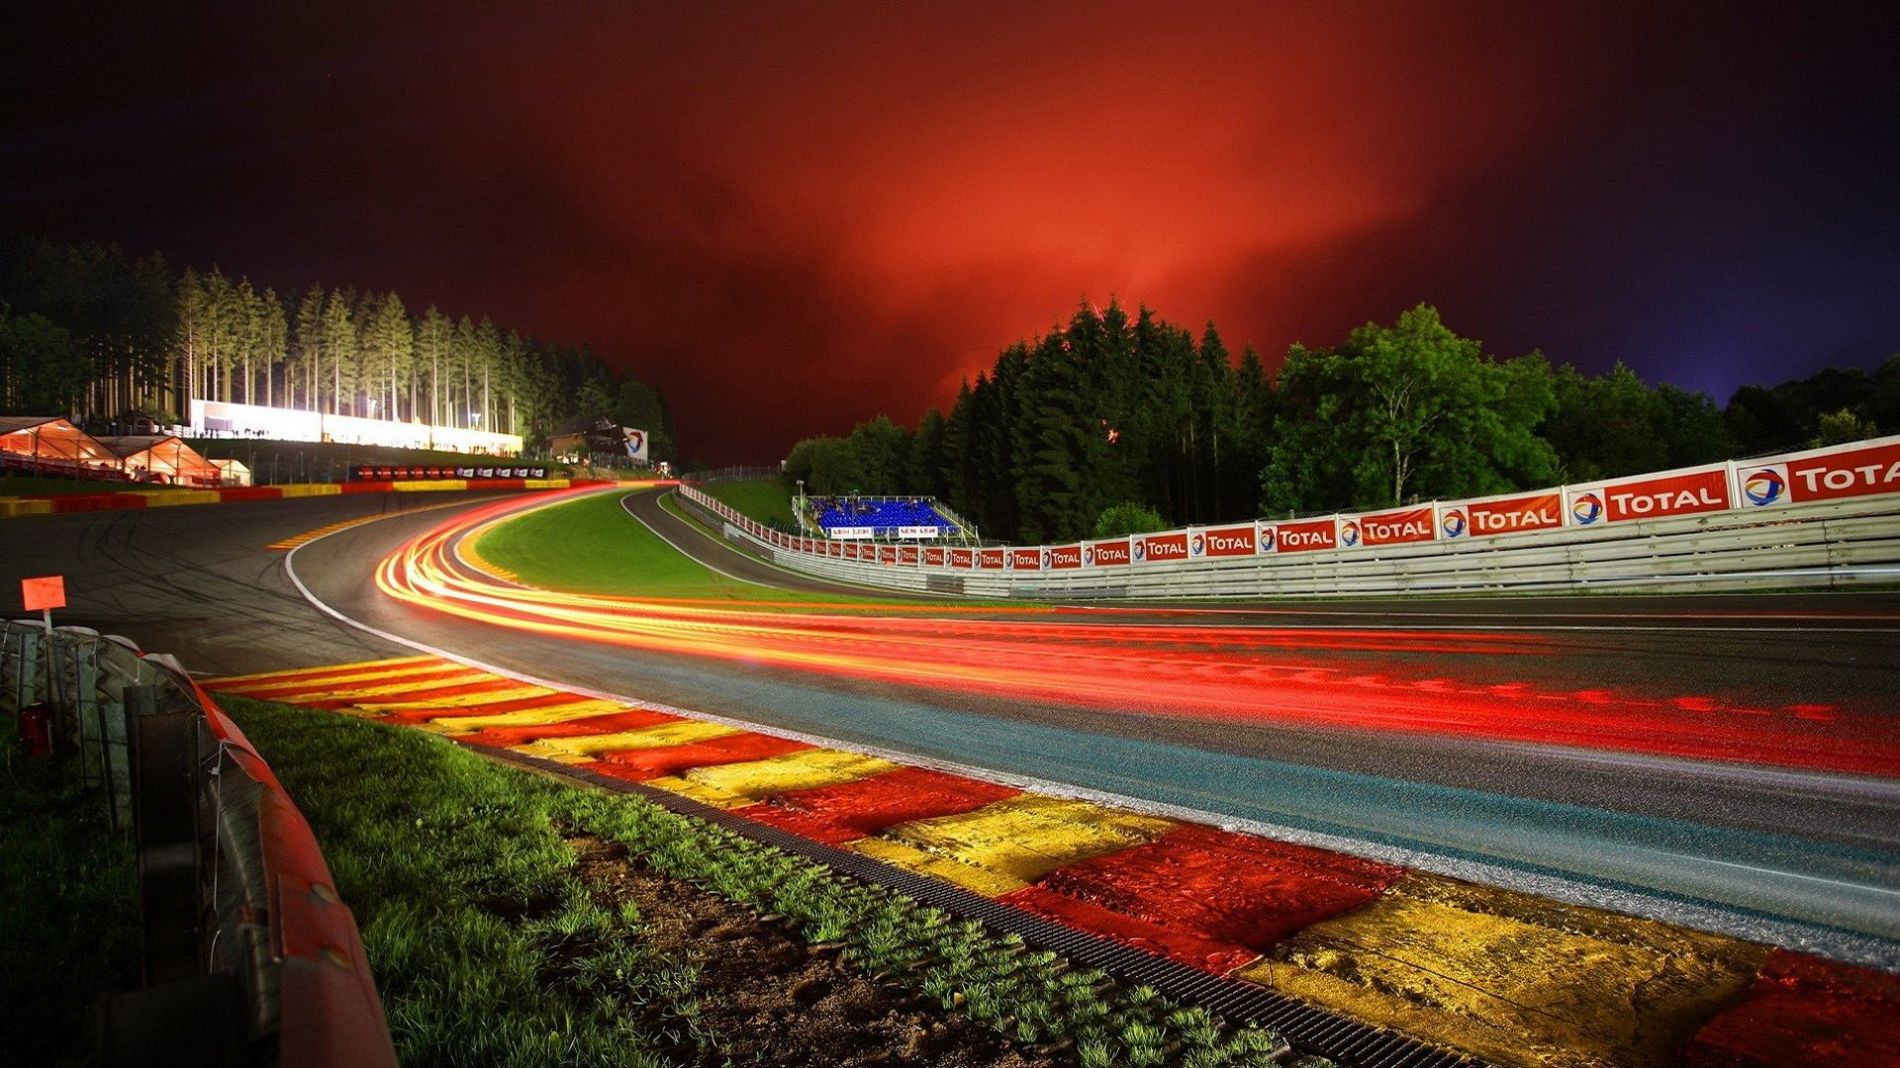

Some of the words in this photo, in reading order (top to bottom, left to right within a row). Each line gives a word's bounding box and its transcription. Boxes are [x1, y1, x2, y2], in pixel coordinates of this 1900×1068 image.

[1611, 488, 1722, 515] TOTAL
[1472, 508, 1558, 530] TOTAL
[1364, 521, 1431, 540] TOTAL
[1208, 536, 1254, 550] TOTAL
[1279, 530, 1334, 546] TOTAL
[1095, 548, 1129, 560] TOTAL
[1147, 542, 1186, 555] TOTAL
[926, 551, 943, 562] TOTAL
[952, 552, 972, 564] TOTAL
[982, 553, 1003, 565] TOTAL
[1014, 553, 1039, 565] TOTAL
[1052, 552, 1080, 564] TOTAL
